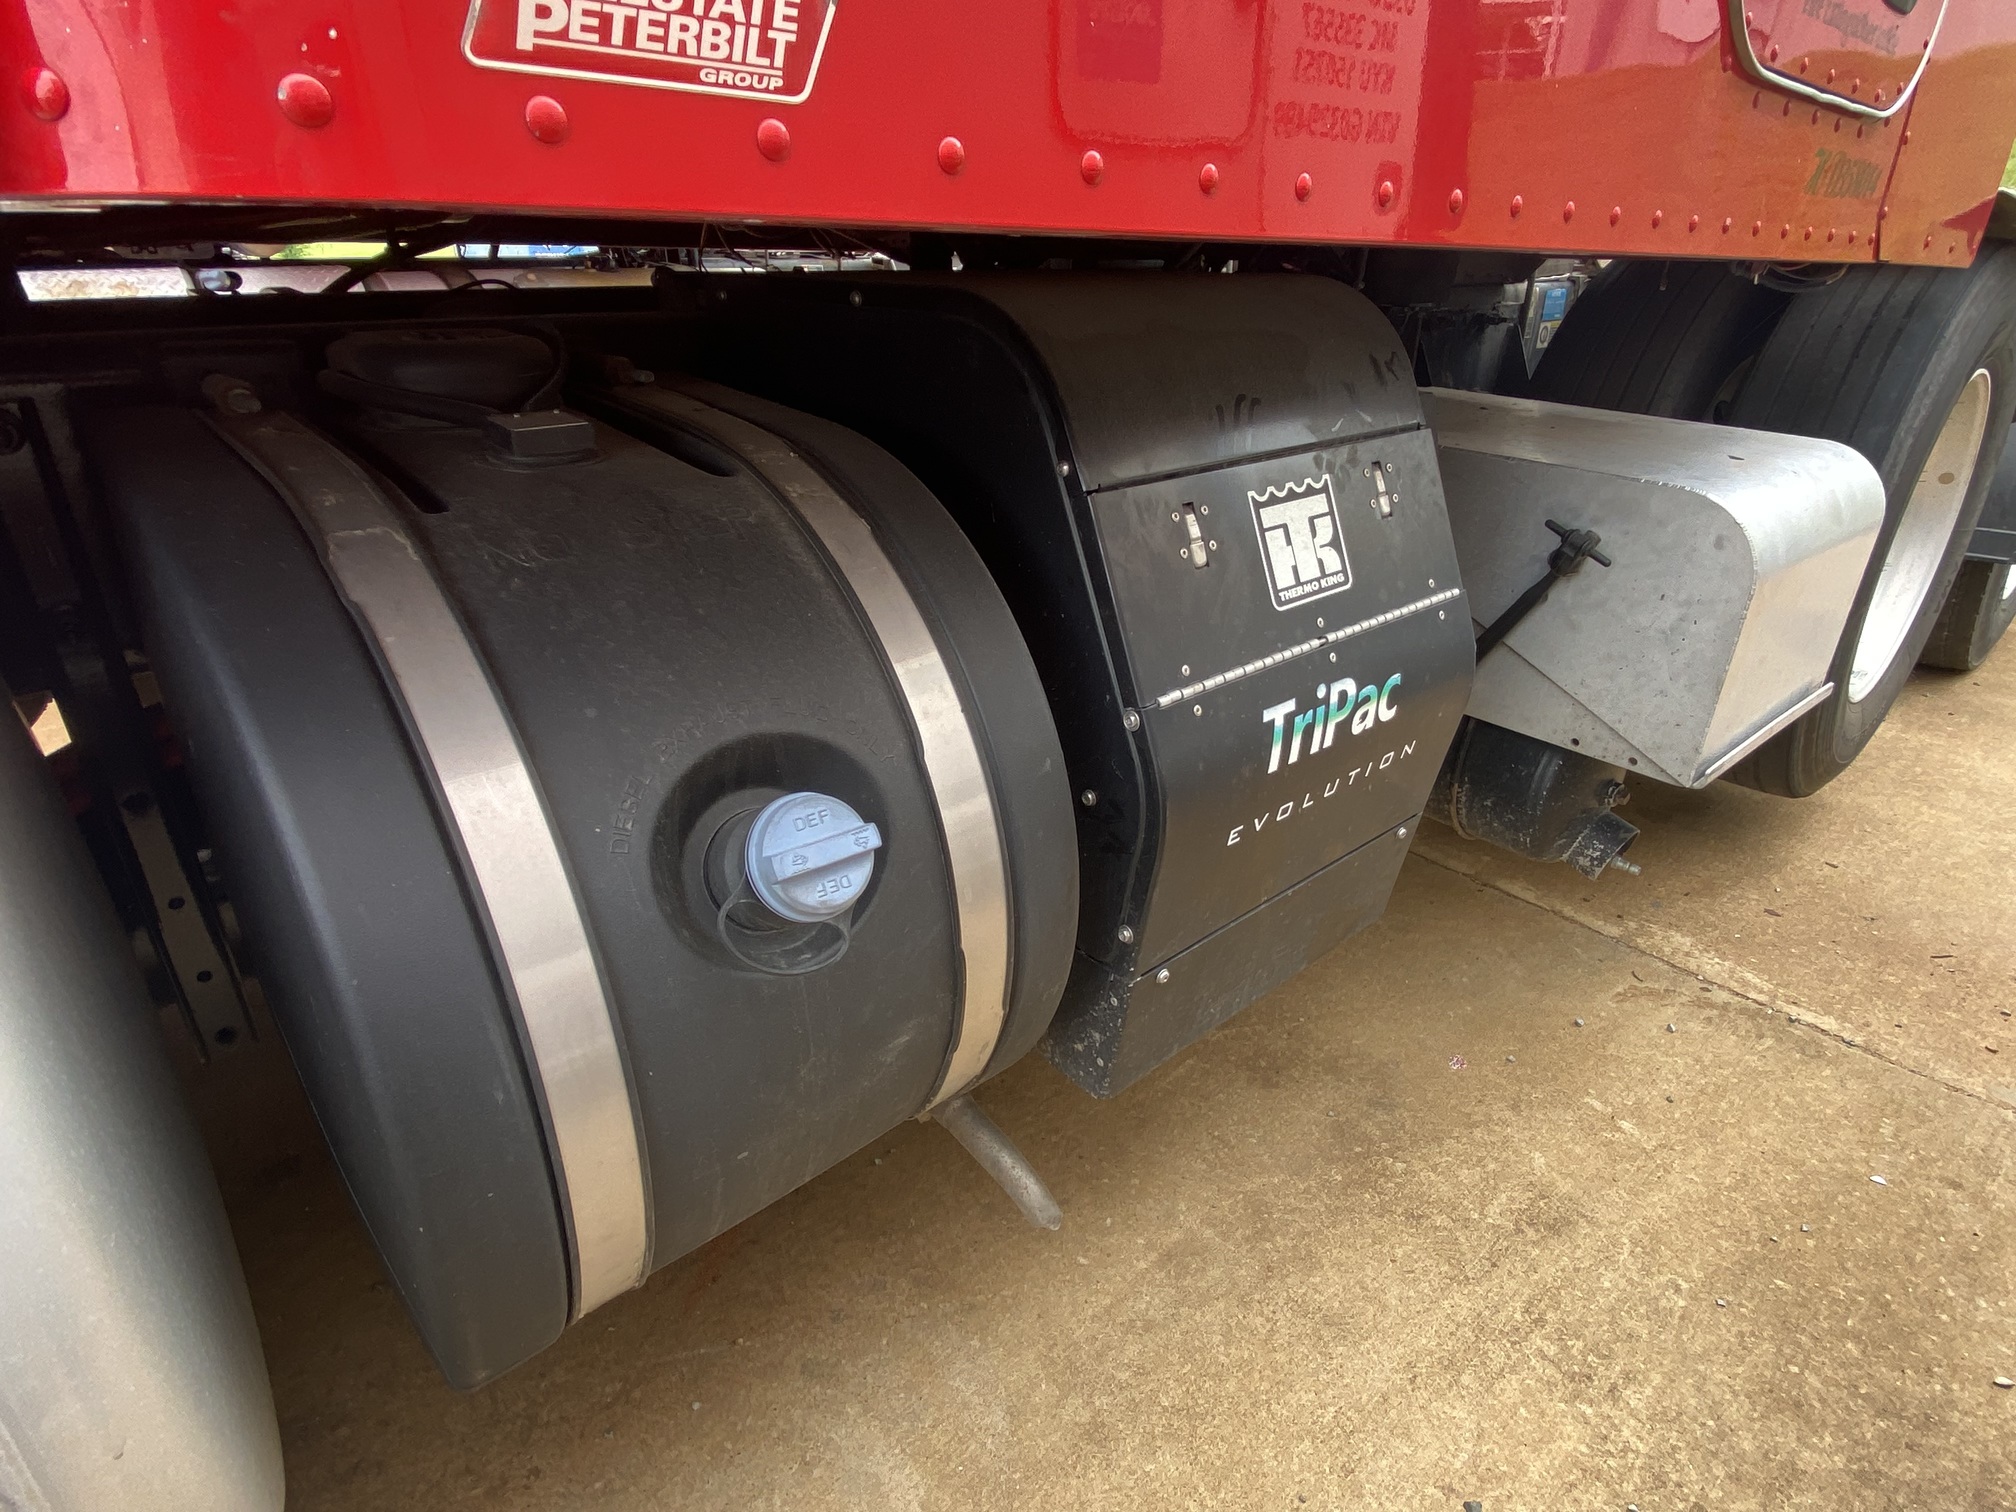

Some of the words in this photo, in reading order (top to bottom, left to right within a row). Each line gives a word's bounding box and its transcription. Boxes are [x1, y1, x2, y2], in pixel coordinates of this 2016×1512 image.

[515, 0, 798, 68] PETERBILT
[699, 67, 785, 92] GROUP
[1278, 581, 1320, 602] THERMO
[1320, 572, 1346, 589] KING
[1262, 672, 1402, 775] TriPac
[609, 775, 657, 856] DIESEL
[1226, 739, 1417, 847] EVOLUTION
[792, 808, 831, 833] DEF
[815, 874, 854, 899] DEF
